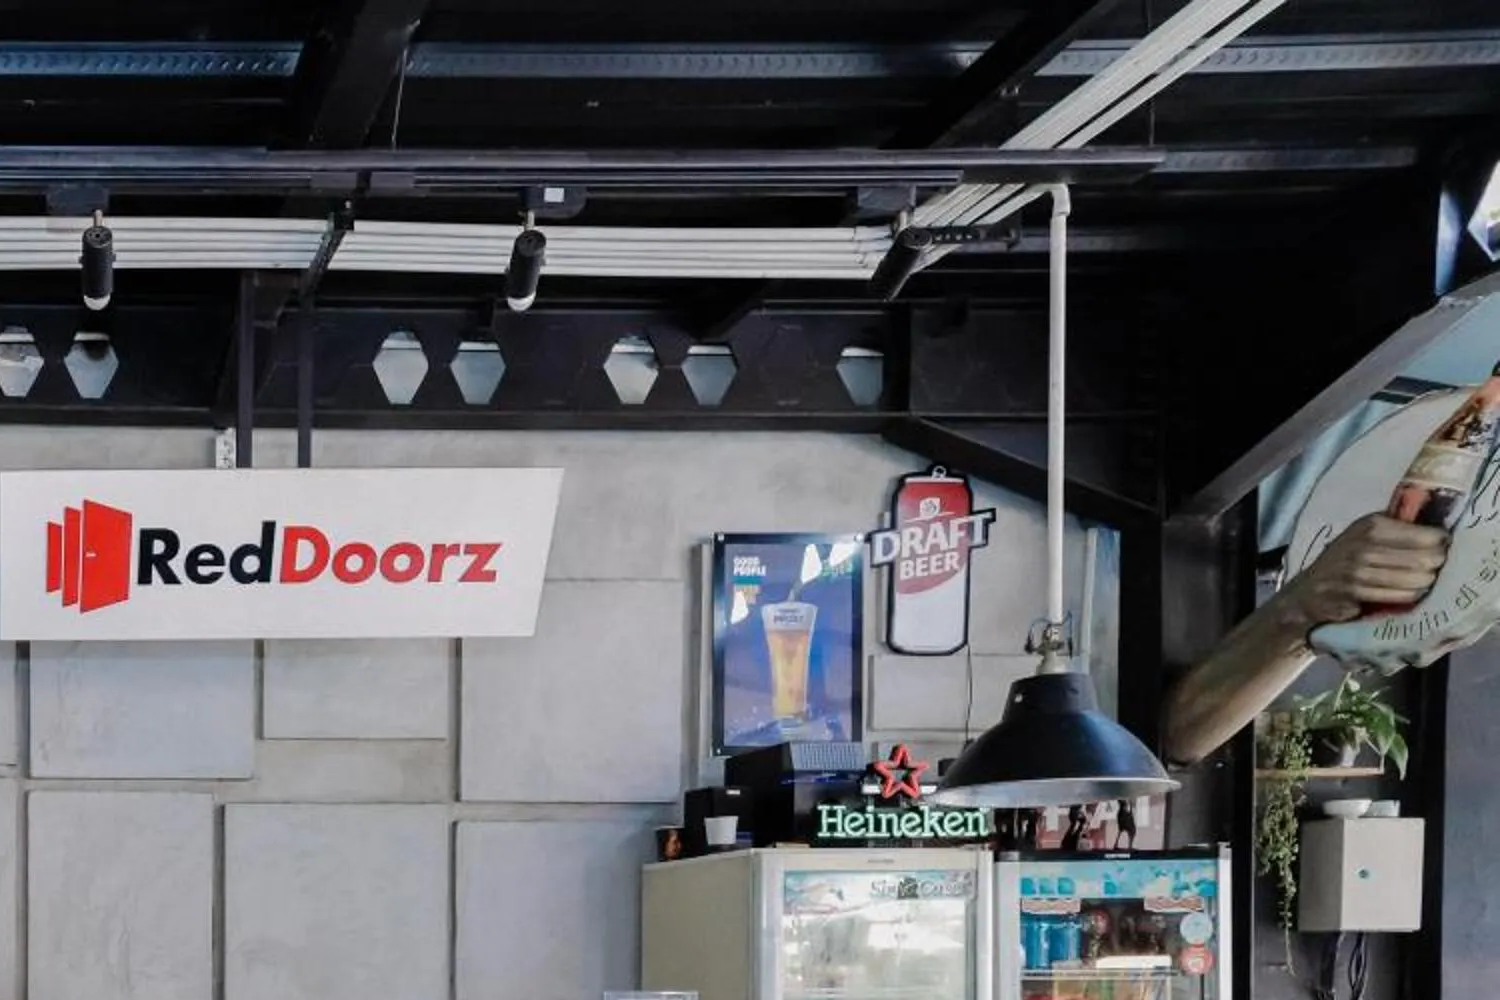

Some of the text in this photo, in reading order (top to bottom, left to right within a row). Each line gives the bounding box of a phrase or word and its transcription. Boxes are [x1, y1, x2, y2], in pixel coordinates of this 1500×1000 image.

[137, 520, 504, 585] RedDoorz
[871, 510, 994, 565] DRAFT
[899, 550, 960, 581] BEER
[816, 804, 990, 838] Heineken
